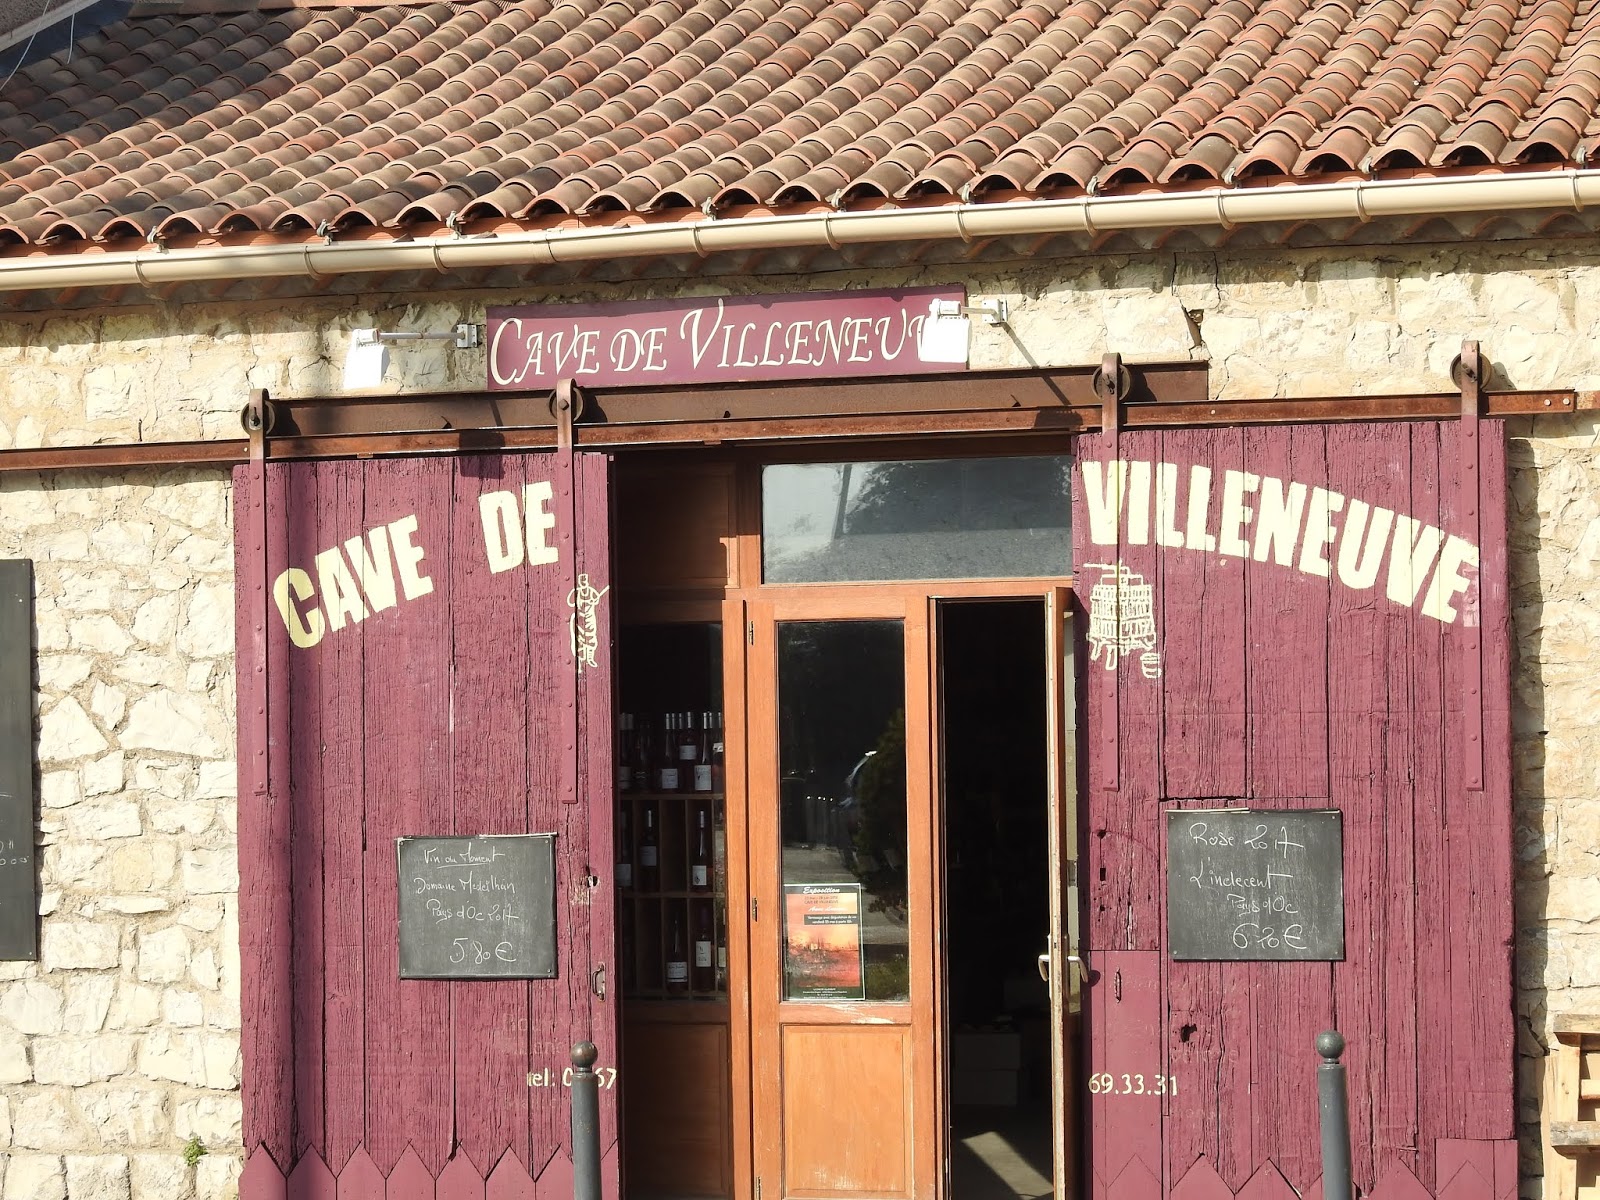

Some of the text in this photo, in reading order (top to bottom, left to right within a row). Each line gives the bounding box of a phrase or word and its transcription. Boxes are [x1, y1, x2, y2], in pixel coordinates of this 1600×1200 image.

[490, 318, 600, 385] CAVE
[610, 327, 667, 373] DE
[273, 461, 1480, 649] CAVE DE VILLENEUVE
[424, 847, 440, 864] Vin
[413, 877, 457, 895] Domaine
[803, 886, 841, 894] Exposition
[426, 898, 453, 925] Pays
[1088, 1072, 1178, 1097] 69.33.31
